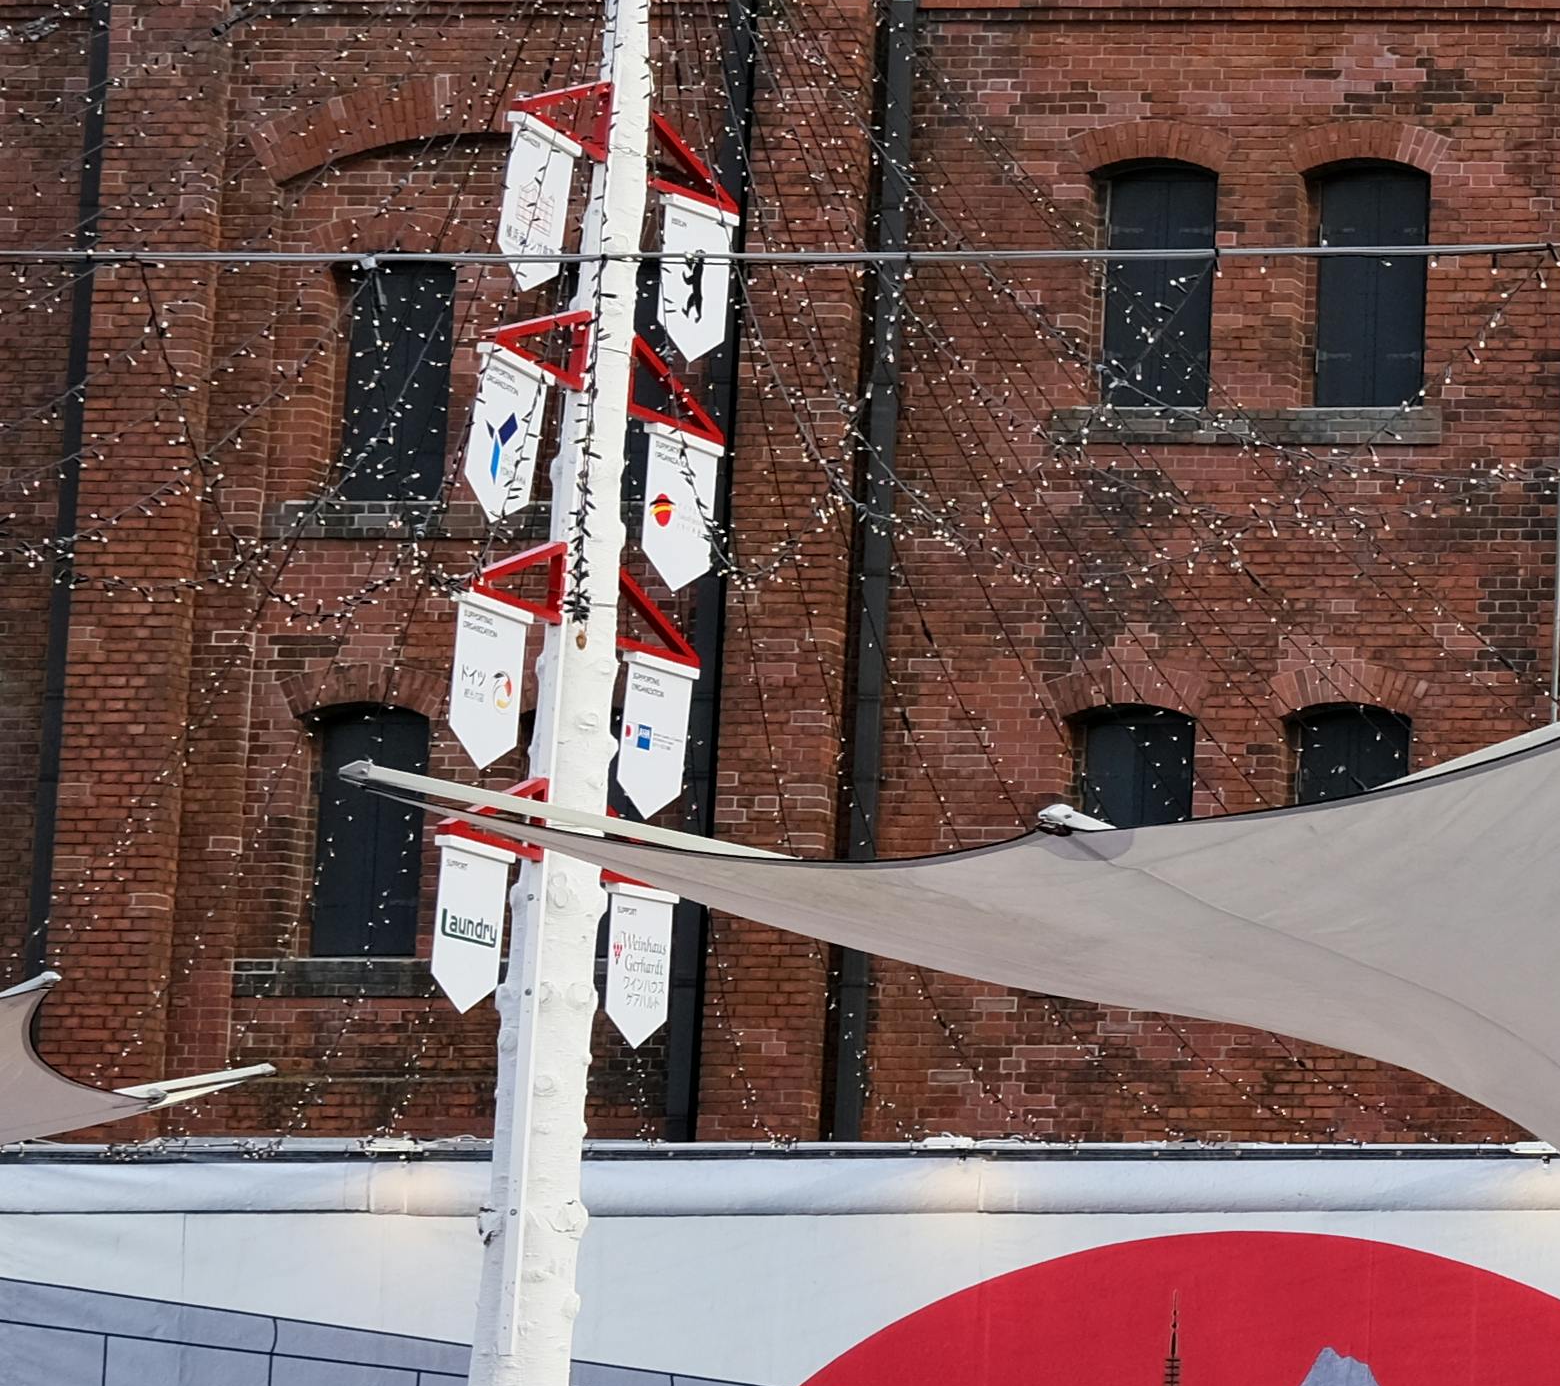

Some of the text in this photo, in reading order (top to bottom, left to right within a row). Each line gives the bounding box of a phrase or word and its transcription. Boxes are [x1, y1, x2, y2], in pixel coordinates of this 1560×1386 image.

[461, 663, 487, 688] ドイツ
[441, 907, 498, 949] Laundry
[621, 931, 667, 956] Weinhaus
[624, 953, 664, 976] Gerhardt
